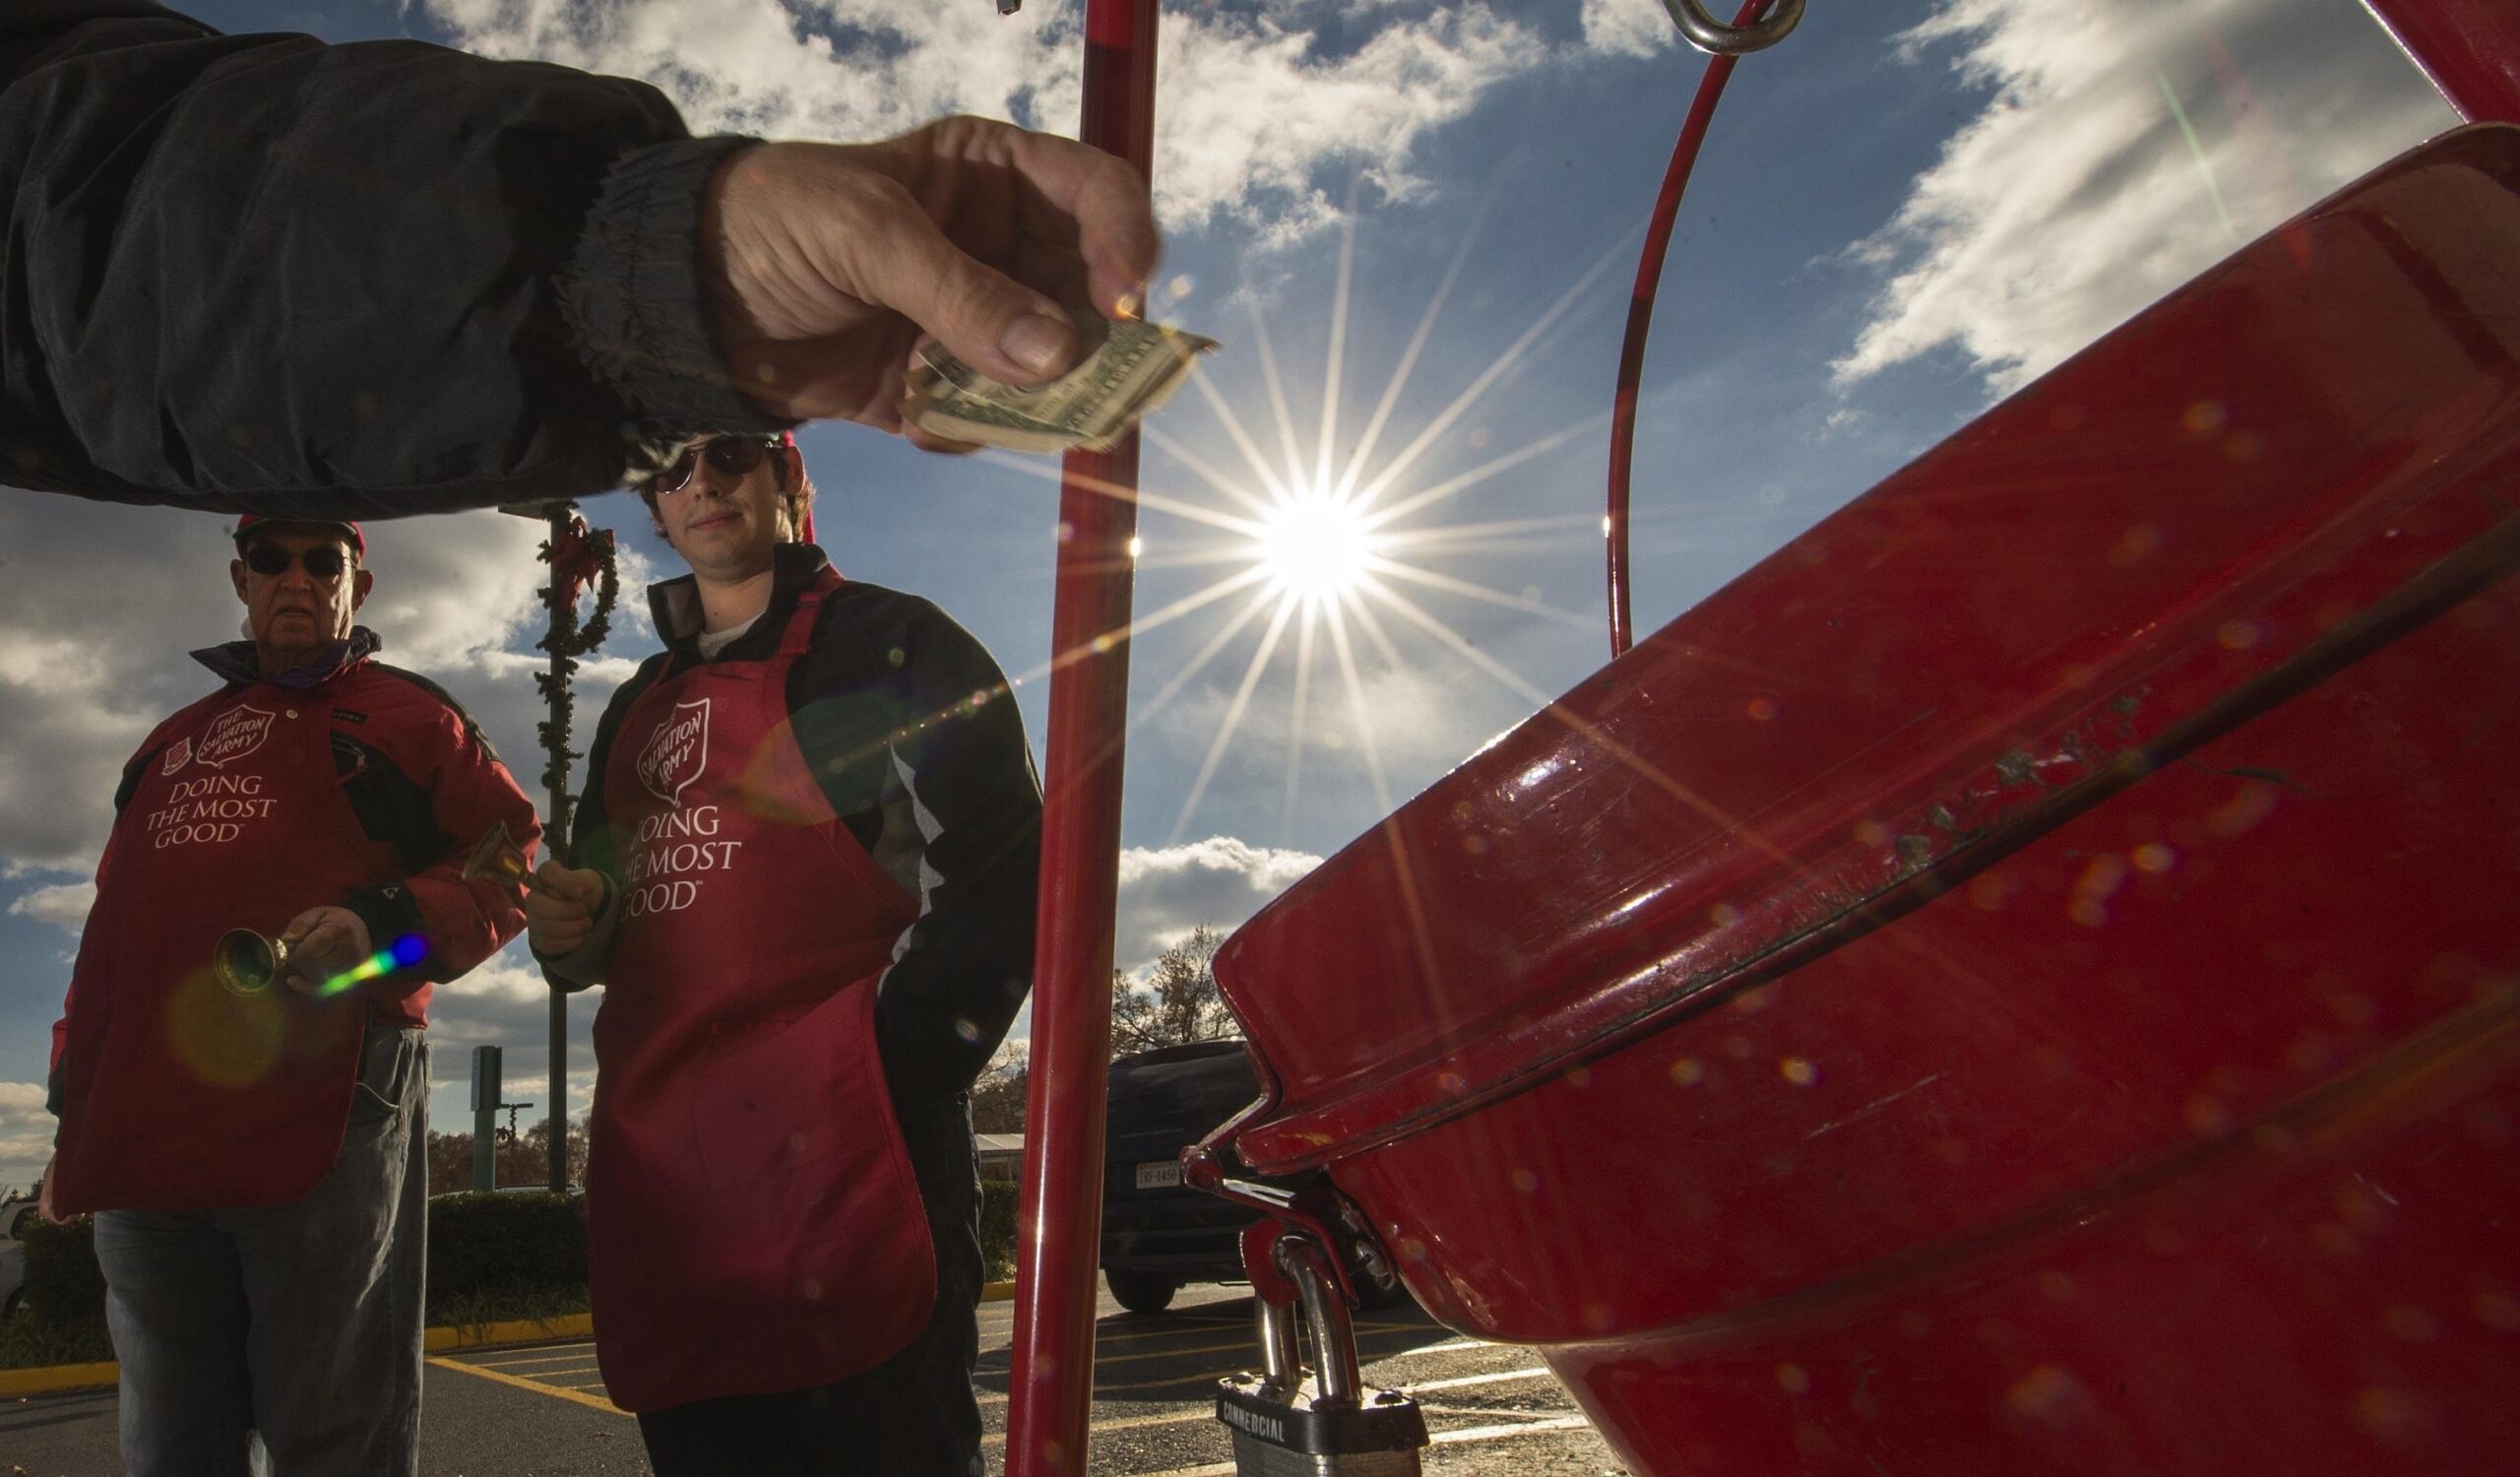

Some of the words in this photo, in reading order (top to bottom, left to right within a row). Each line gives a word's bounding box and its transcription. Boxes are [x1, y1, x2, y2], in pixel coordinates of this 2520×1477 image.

[200, 716, 266, 757] SALVATION
[217, 710, 243, 734] THE
[211, 732, 258, 759] ARMY
[641, 710, 702, 786] SALVATION
[659, 738, 695, 793] ARMY
[168, 775, 262, 804] DOING
[148, 803, 189, 831] THE
[192, 799, 278, 819] MOST
[155, 823, 239, 849] GOOD
[646, 841, 742, 878] MOST
[1224, 1401, 1285, 1443] COMMERCIAL
